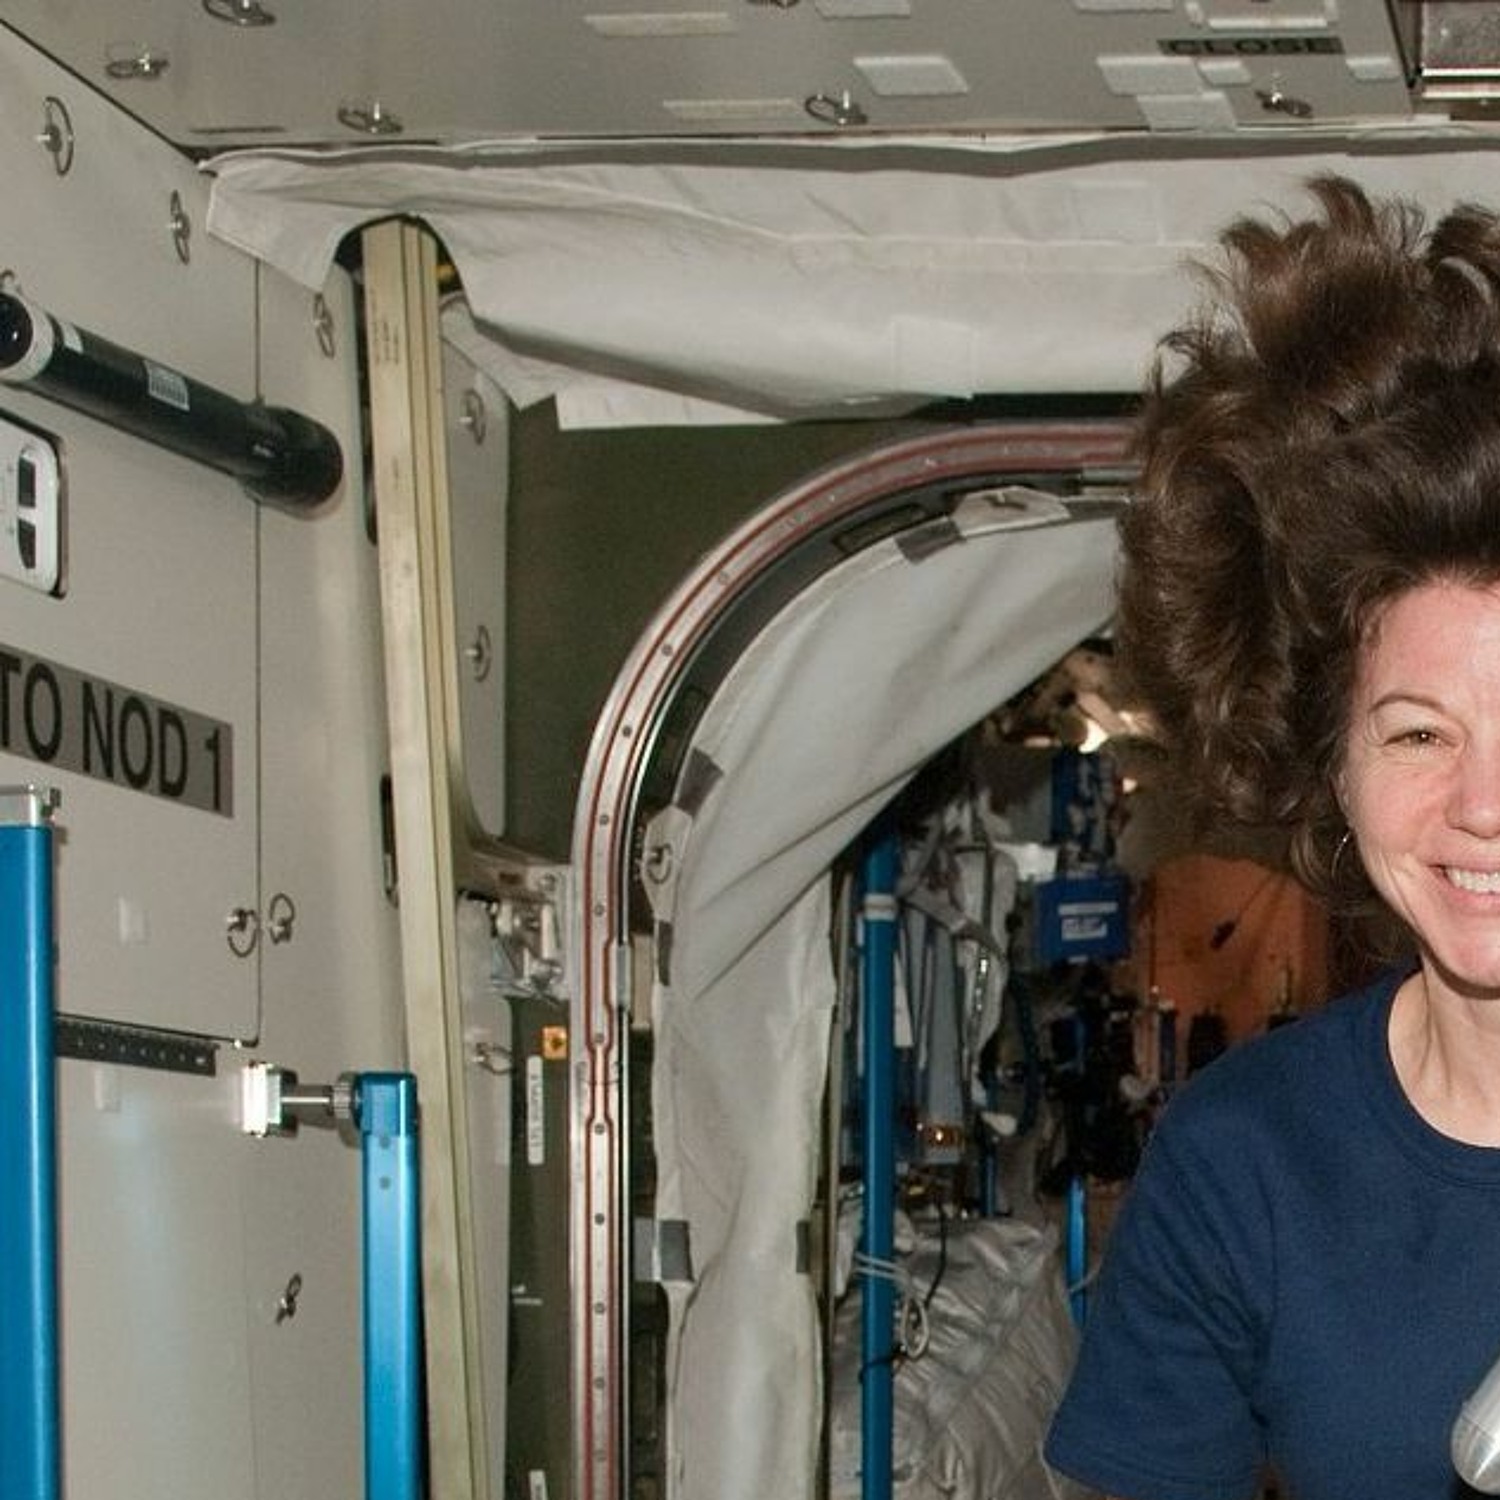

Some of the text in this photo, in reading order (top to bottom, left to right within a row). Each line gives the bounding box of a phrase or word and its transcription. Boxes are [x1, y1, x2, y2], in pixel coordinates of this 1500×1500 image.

[0, 652, 221, 812] TO NOD 1
